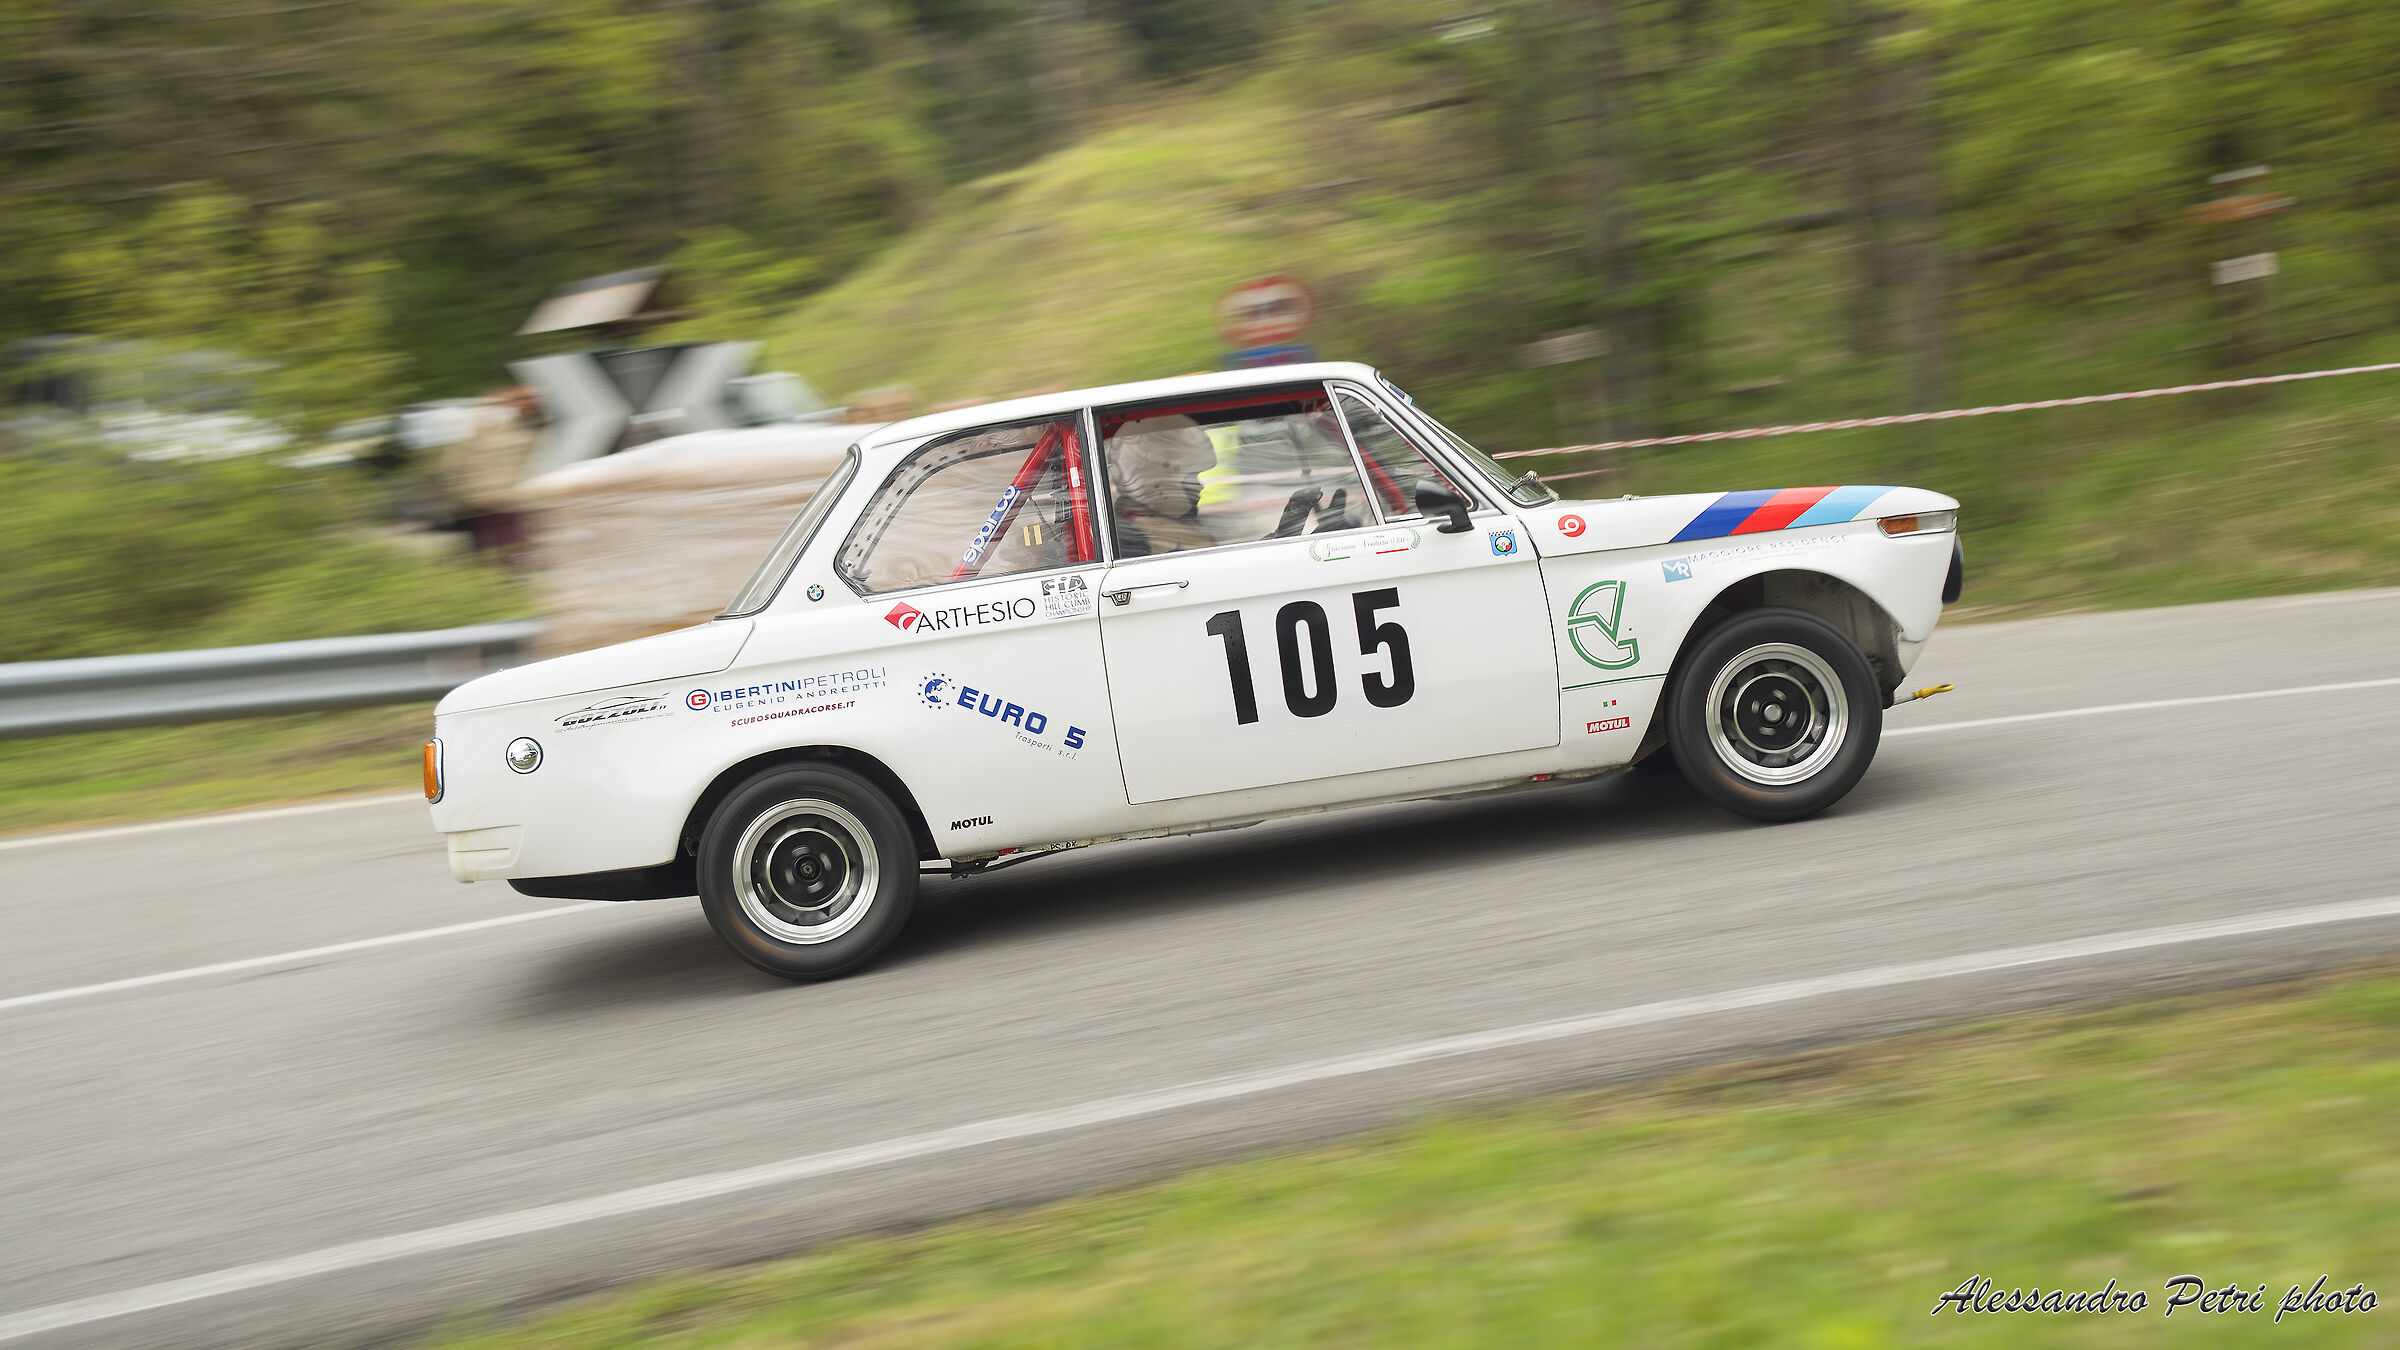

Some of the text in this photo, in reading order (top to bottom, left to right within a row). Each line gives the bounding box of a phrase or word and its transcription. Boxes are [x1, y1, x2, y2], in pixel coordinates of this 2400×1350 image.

[962, 485, 1017, 563] sparco
[1044, 590, 1090, 604] HISTORIC
[1045, 598, 1091, 612] HILL CLIMB
[1205, 587, 1415, 725] 105
[714, 681, 887, 713] EUGENIO ANDREOTTI
[731, 700, 856, 728] SCUBOSQUADRACORSE.IT
[957, 685, 1087, 750] EURO 5
[1588, 718, 1629, 733] MOTUL
[1015, 731, 1053, 752] Trasporti
[951, 815, 994, 831] MOTUL
